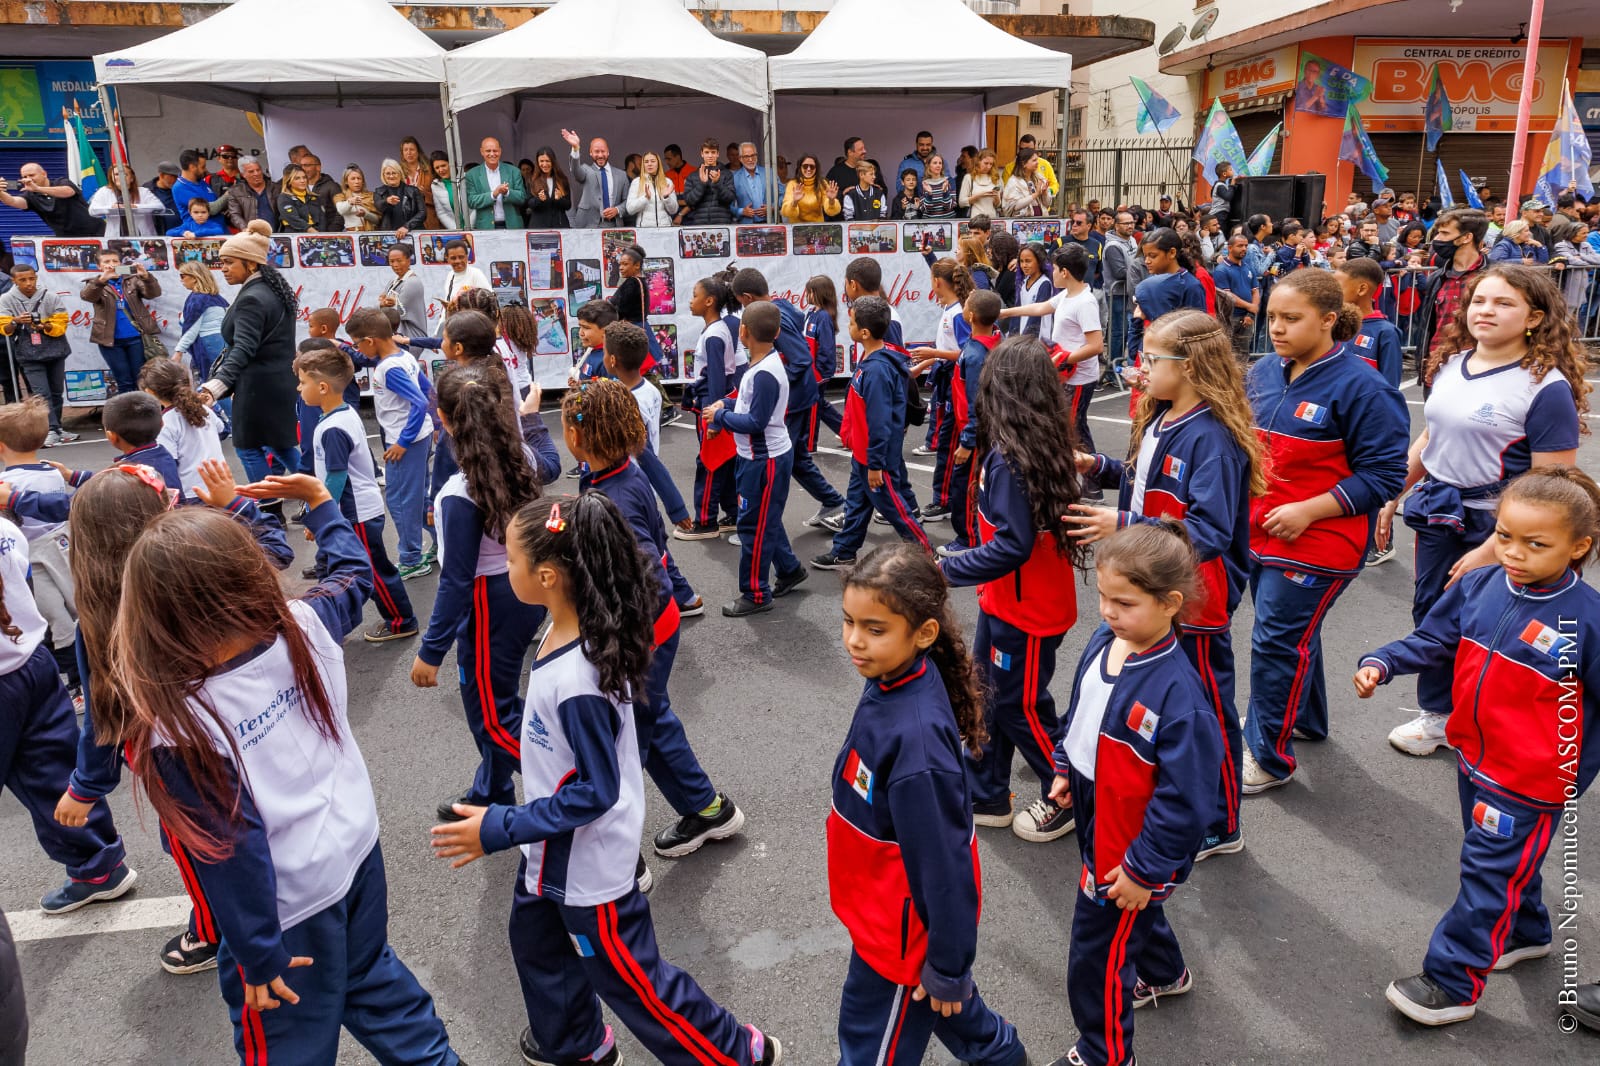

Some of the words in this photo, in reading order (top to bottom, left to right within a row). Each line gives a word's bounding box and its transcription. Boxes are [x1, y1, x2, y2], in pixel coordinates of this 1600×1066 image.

[1404, 48, 1452, 59] CENTRAL
[1457, 49, 1472, 58] DE
[1477, 47, 1521, 59] CRÉDITO
[1224, 59, 1275, 89] BMG
[1371, 58, 1544, 104] BMG
[65, 108, 100, 119] BLLET
[234, 684, 300, 738] Teresóp
[242, 719, 275, 751] orgulho
